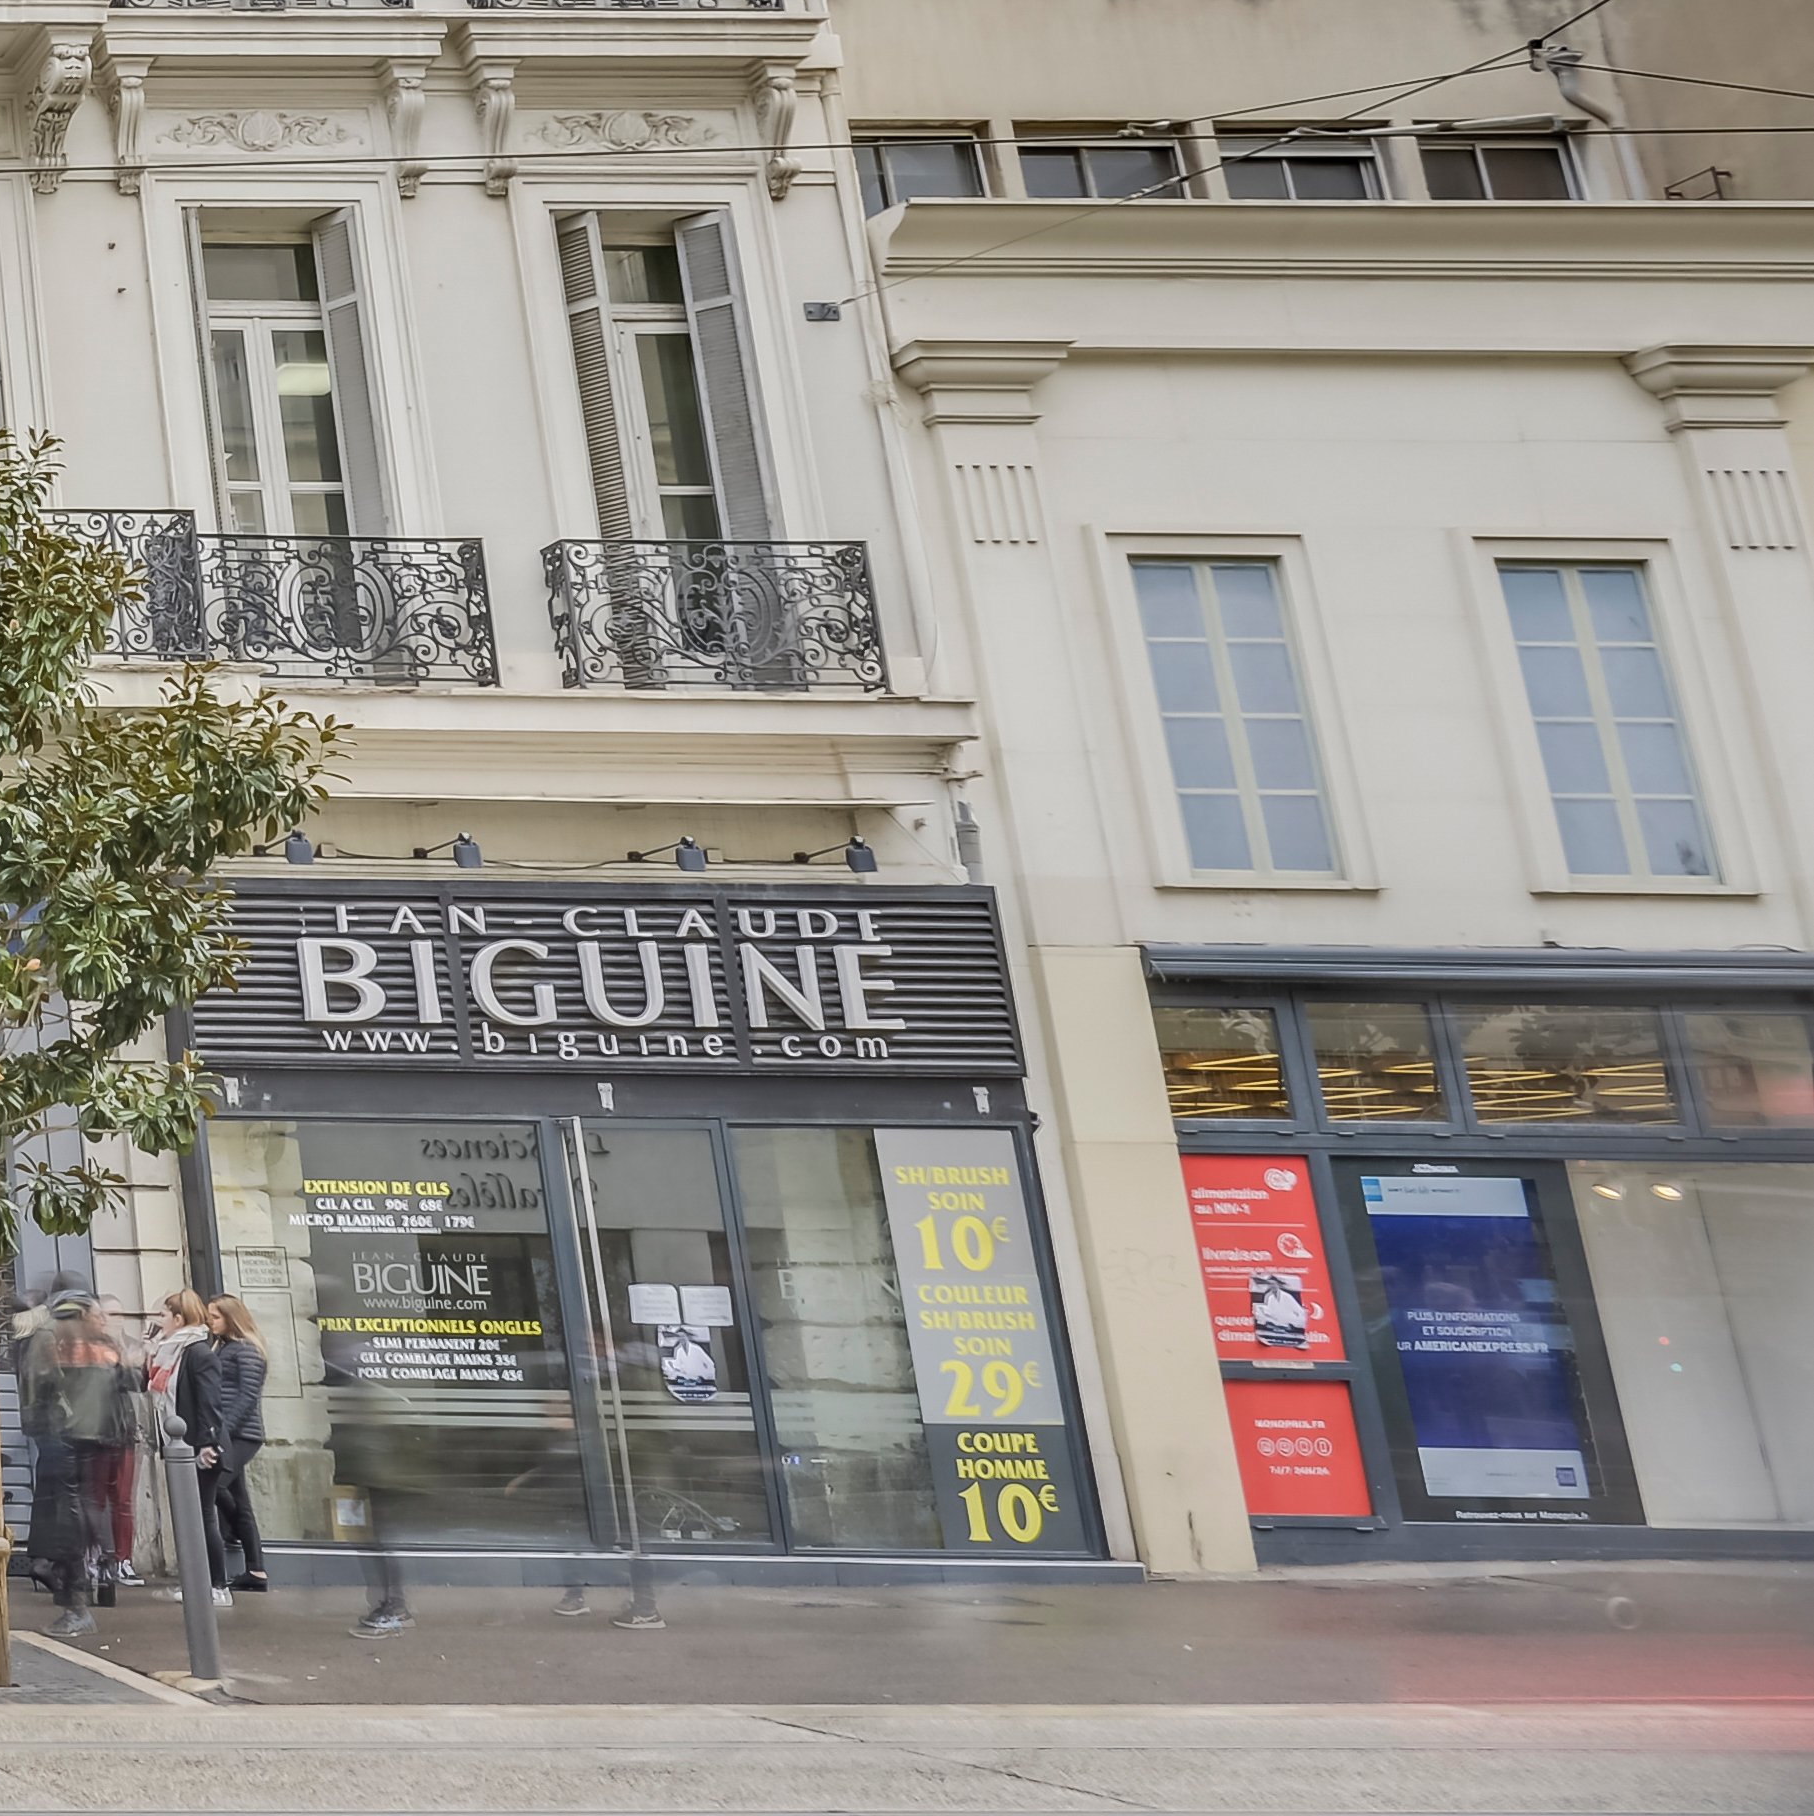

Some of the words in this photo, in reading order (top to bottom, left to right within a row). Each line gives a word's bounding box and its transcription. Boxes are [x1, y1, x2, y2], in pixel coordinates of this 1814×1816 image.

[296, 937, 907, 1031] BIGUINE
[322, 1022, 889, 1061] www.biguine.com
[894, 1166, 1010, 1186] SH/BRUSH
[304, 1179, 387, 1195] EXTENSION
[391, 1181, 412, 1195] DE
[415, 1181, 451, 1196] CILS
[316, 1198, 340, 1211] CIL
[341, 1199, 351, 1211] A
[353, 1198, 375, 1211] CIL
[927, 1191, 986, 1211] SOIN
[289, 1214, 334, 1226] MICRO
[337, 1214, 395, 1227] BLADING
[914, 1214, 1011, 1272] 10€
[352, 1263, 492, 1295] BIGUINE
[363, 1295, 487, 1313] www.biguine.com
[917, 1285, 1029, 1304] COULEUR
[317, 1317, 353, 1332] PRIX
[355, 1318, 477, 1334] EXCEPTIONNELS
[479, 1320, 542, 1335] ONGLES
[919, 1310, 1036, 1330] SH/BRUSH
[372, 1337, 402, 1349] SEMI
[404, 1337, 476, 1350] PERMANENT
[953, 1337, 1013, 1356] SOIN
[359, 1352, 382, 1364] GEL
[384, 1352, 451, 1365] COMBLAGE
[453, 1353, 493, 1366] MAINS
[357, 1366, 389, 1379] POSE
[391, 1367, 457, 1380] COMBLAGE
[459, 1368, 499, 1381] MAINS
[939, 1359, 1043, 1417] 29€
[956, 1432, 1040, 1454] COUPE
[955, 1458, 1050, 1480] HOMME
[957, 1481, 1061, 1543] 10€
